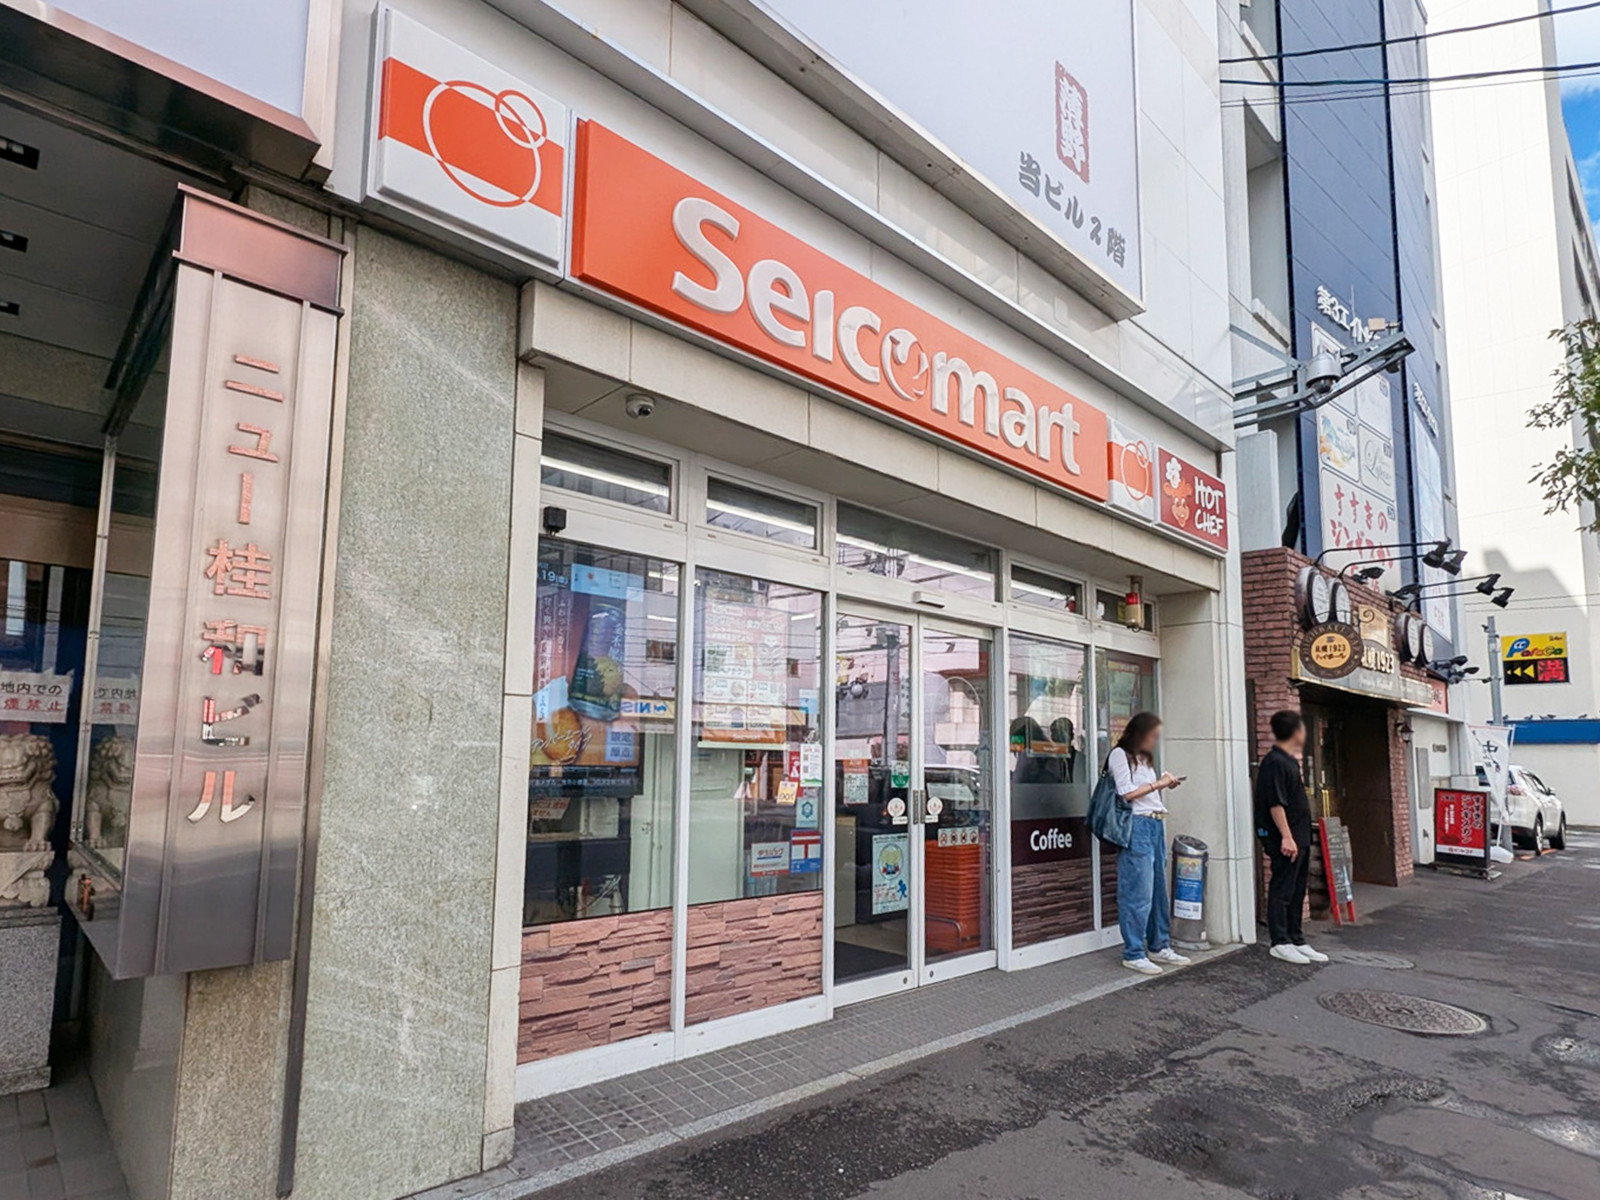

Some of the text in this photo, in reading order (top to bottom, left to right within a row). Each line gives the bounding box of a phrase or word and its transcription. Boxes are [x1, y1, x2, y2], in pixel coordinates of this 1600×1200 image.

[1018, 151, 1126, 268] 当ビル2階
[671, 196, 1081, 477] Seicomart
[1194, 475, 1224, 514] HOT
[1195, 509, 1225, 537] CHEF
[188, 353, 285, 825] ニュー桂和ビル
[0, 682, 63, 696] 地内での
[1030, 828, 1072, 851] Coffee
